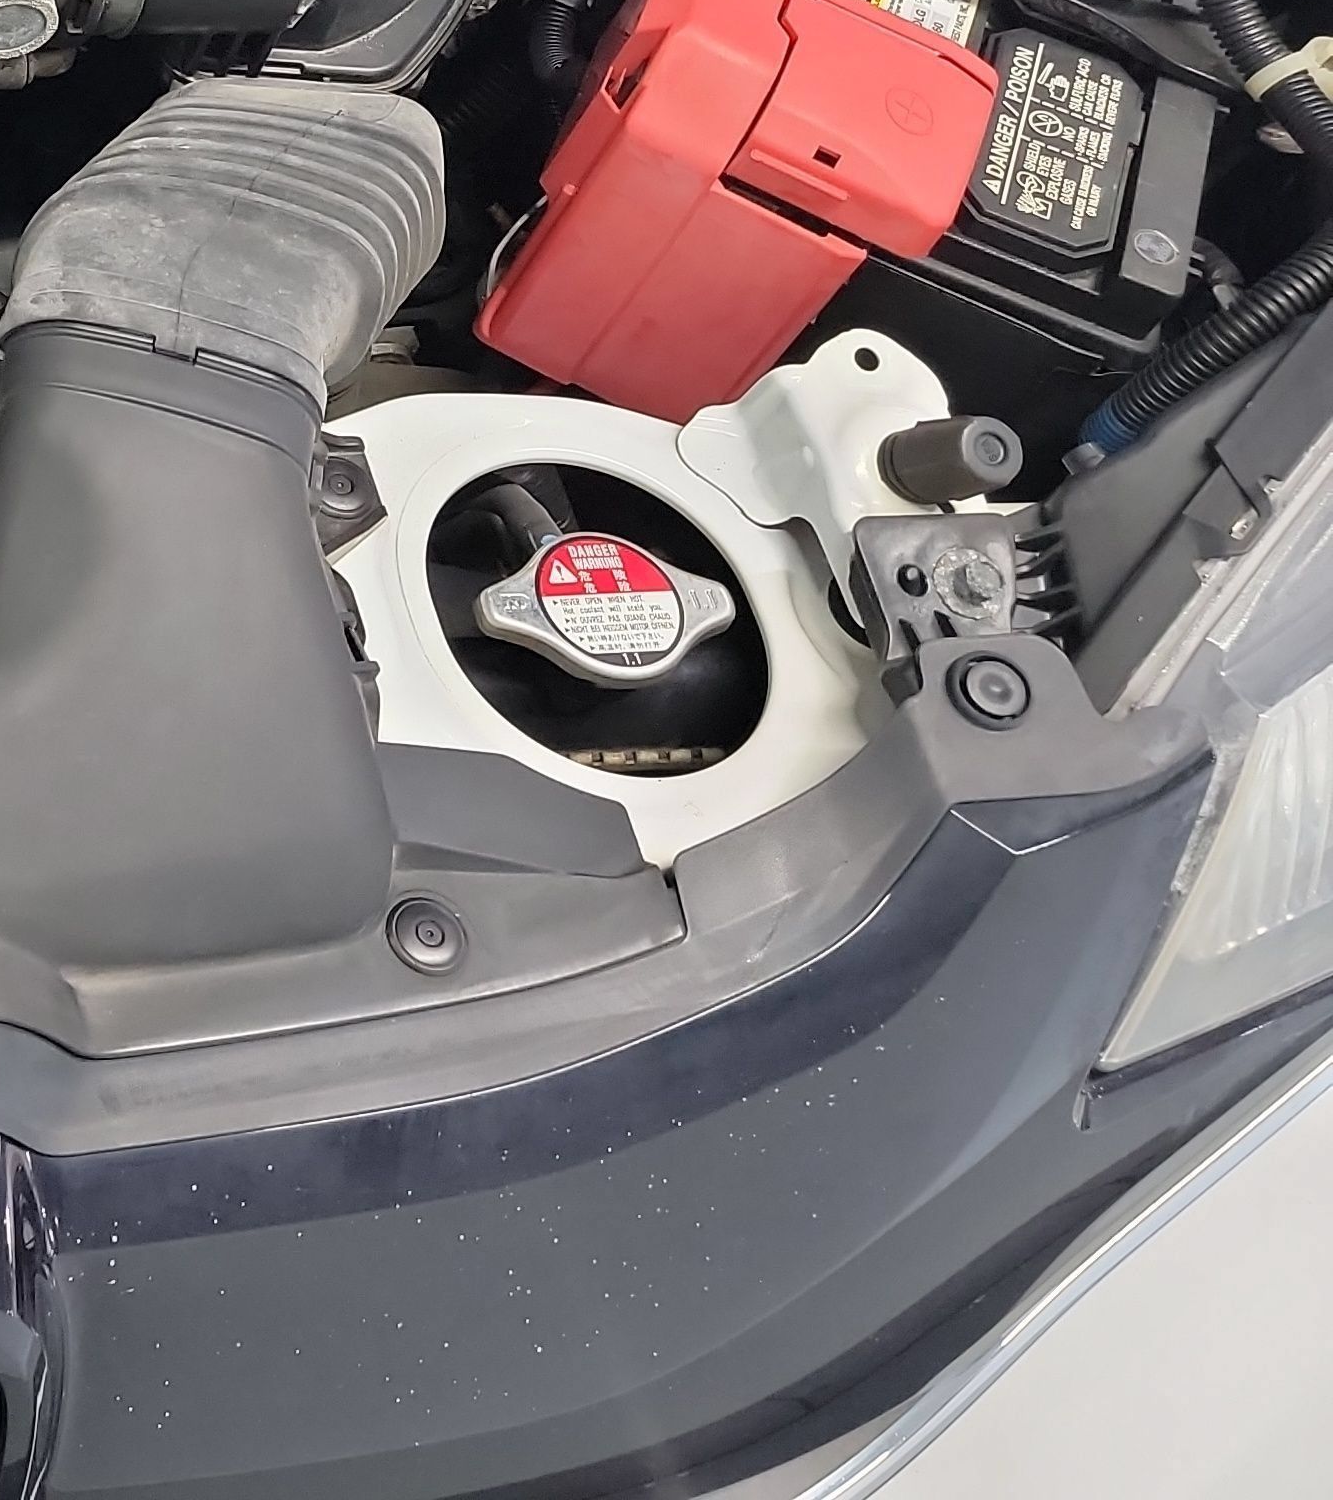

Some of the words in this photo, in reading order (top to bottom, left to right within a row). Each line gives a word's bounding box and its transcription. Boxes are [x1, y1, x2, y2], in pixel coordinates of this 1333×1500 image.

[986, 114, 1018, 179] DANGER
[1005, 46, 1034, 104] POISON
[1062, 126, 1076, 143] NO
[1024, 140, 1039, 171] SHIELD
[1037, 155, 1052, 178] EYES
[1045, 157, 1066, 201] EXPLOSIVE
[1060, 179, 1076, 205] GASES
[568, 544, 619, 558] DANGER
[622, 652, 642, 665] 1.1
